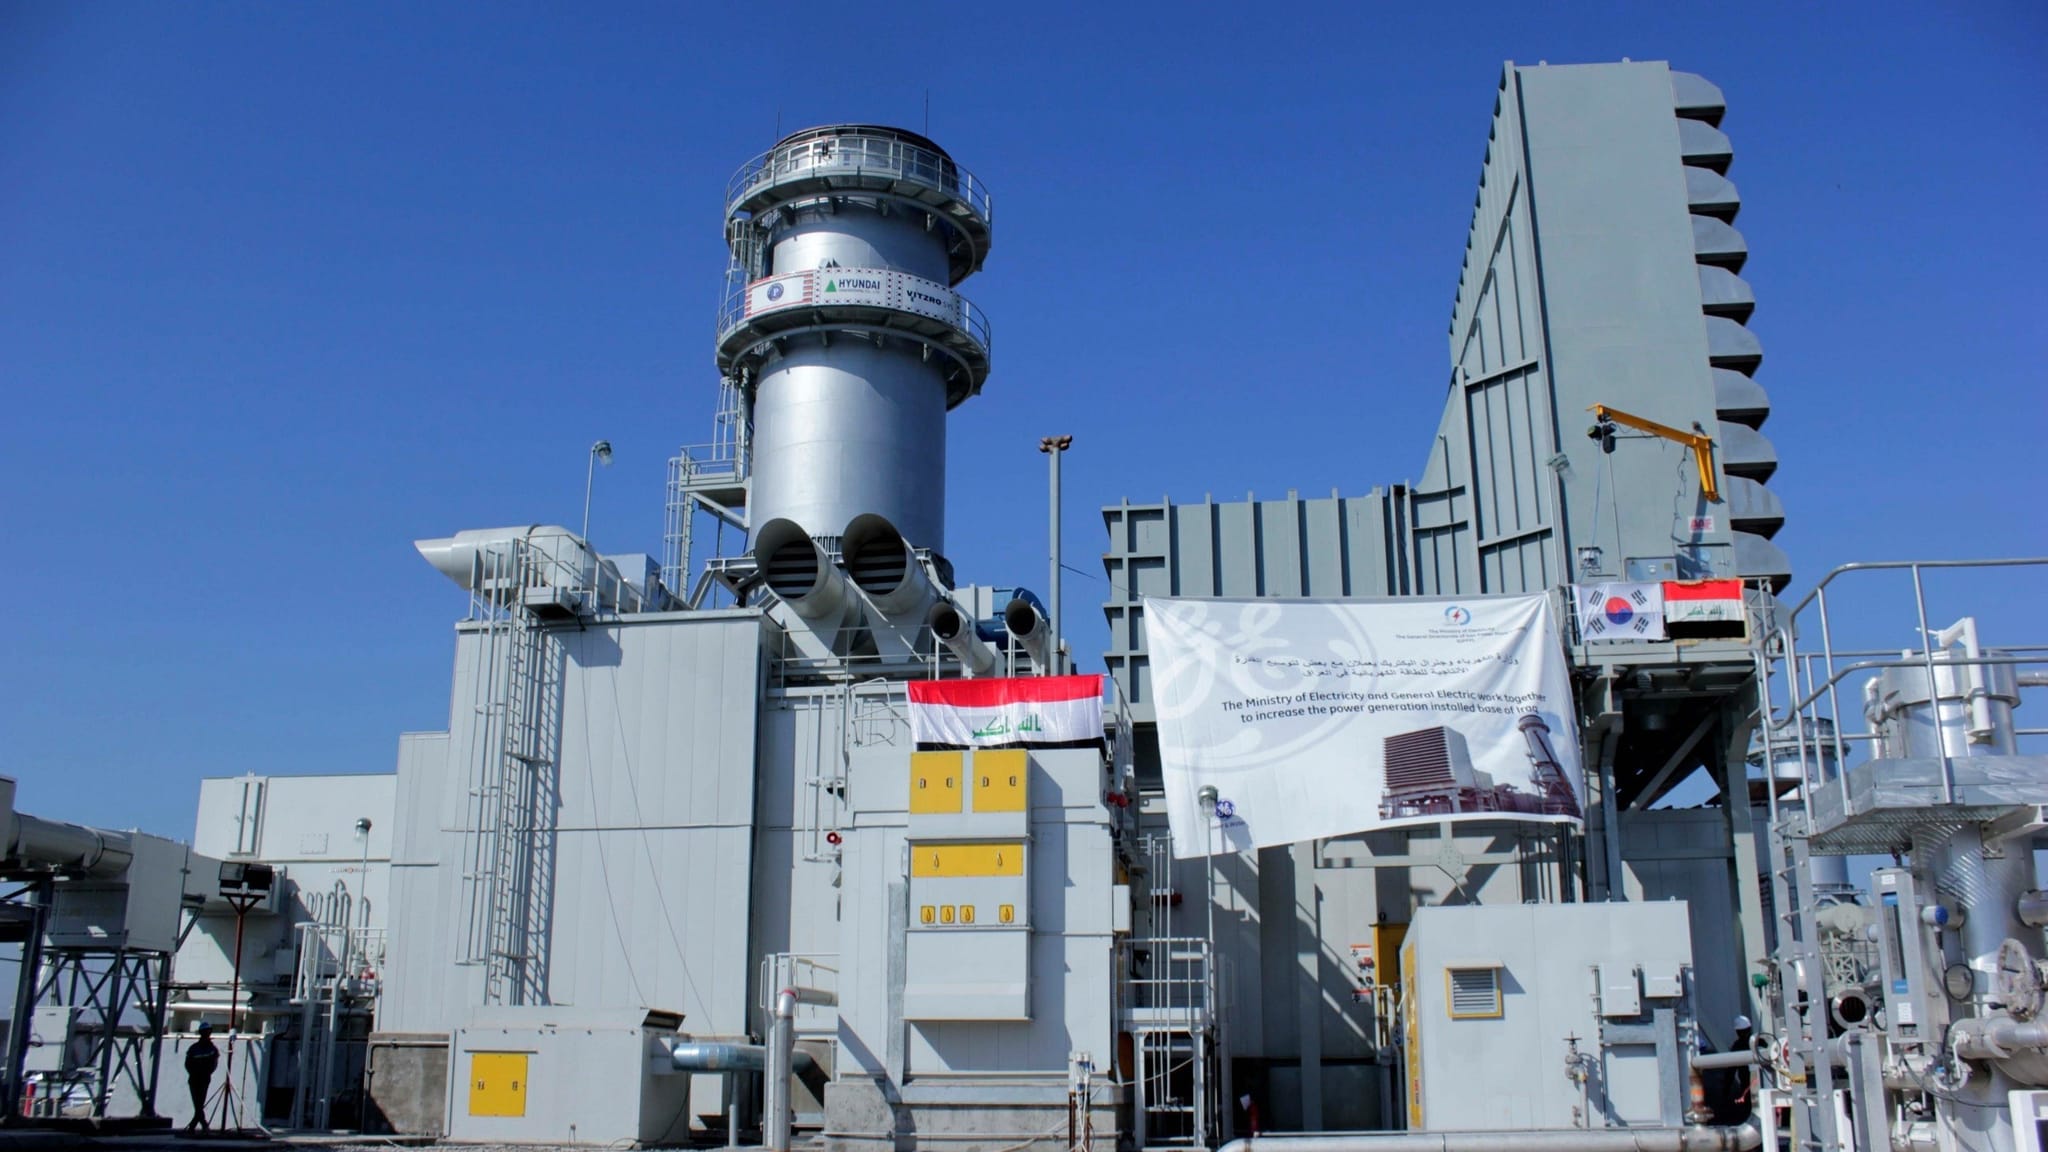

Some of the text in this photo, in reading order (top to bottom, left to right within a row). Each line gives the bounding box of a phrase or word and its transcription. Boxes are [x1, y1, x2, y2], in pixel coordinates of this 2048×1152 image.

[838, 279, 880, 290] HYUNDAI
[906, 290, 942, 306] VITZRO
[1221, 689, 1546, 712] The Ministry of Electricity and General Electric work together
[1240, 713, 1253, 724] to
[1256, 706, 1305, 721] increase
[1308, 704, 1327, 716] the
[1329, 703, 1364, 715] power
[1367, 702, 1428, 715] generation
[1430, 702, 1475, 713] installed
[1477, 703, 1502, 714] base
[1504, 705, 1514, 714] of
